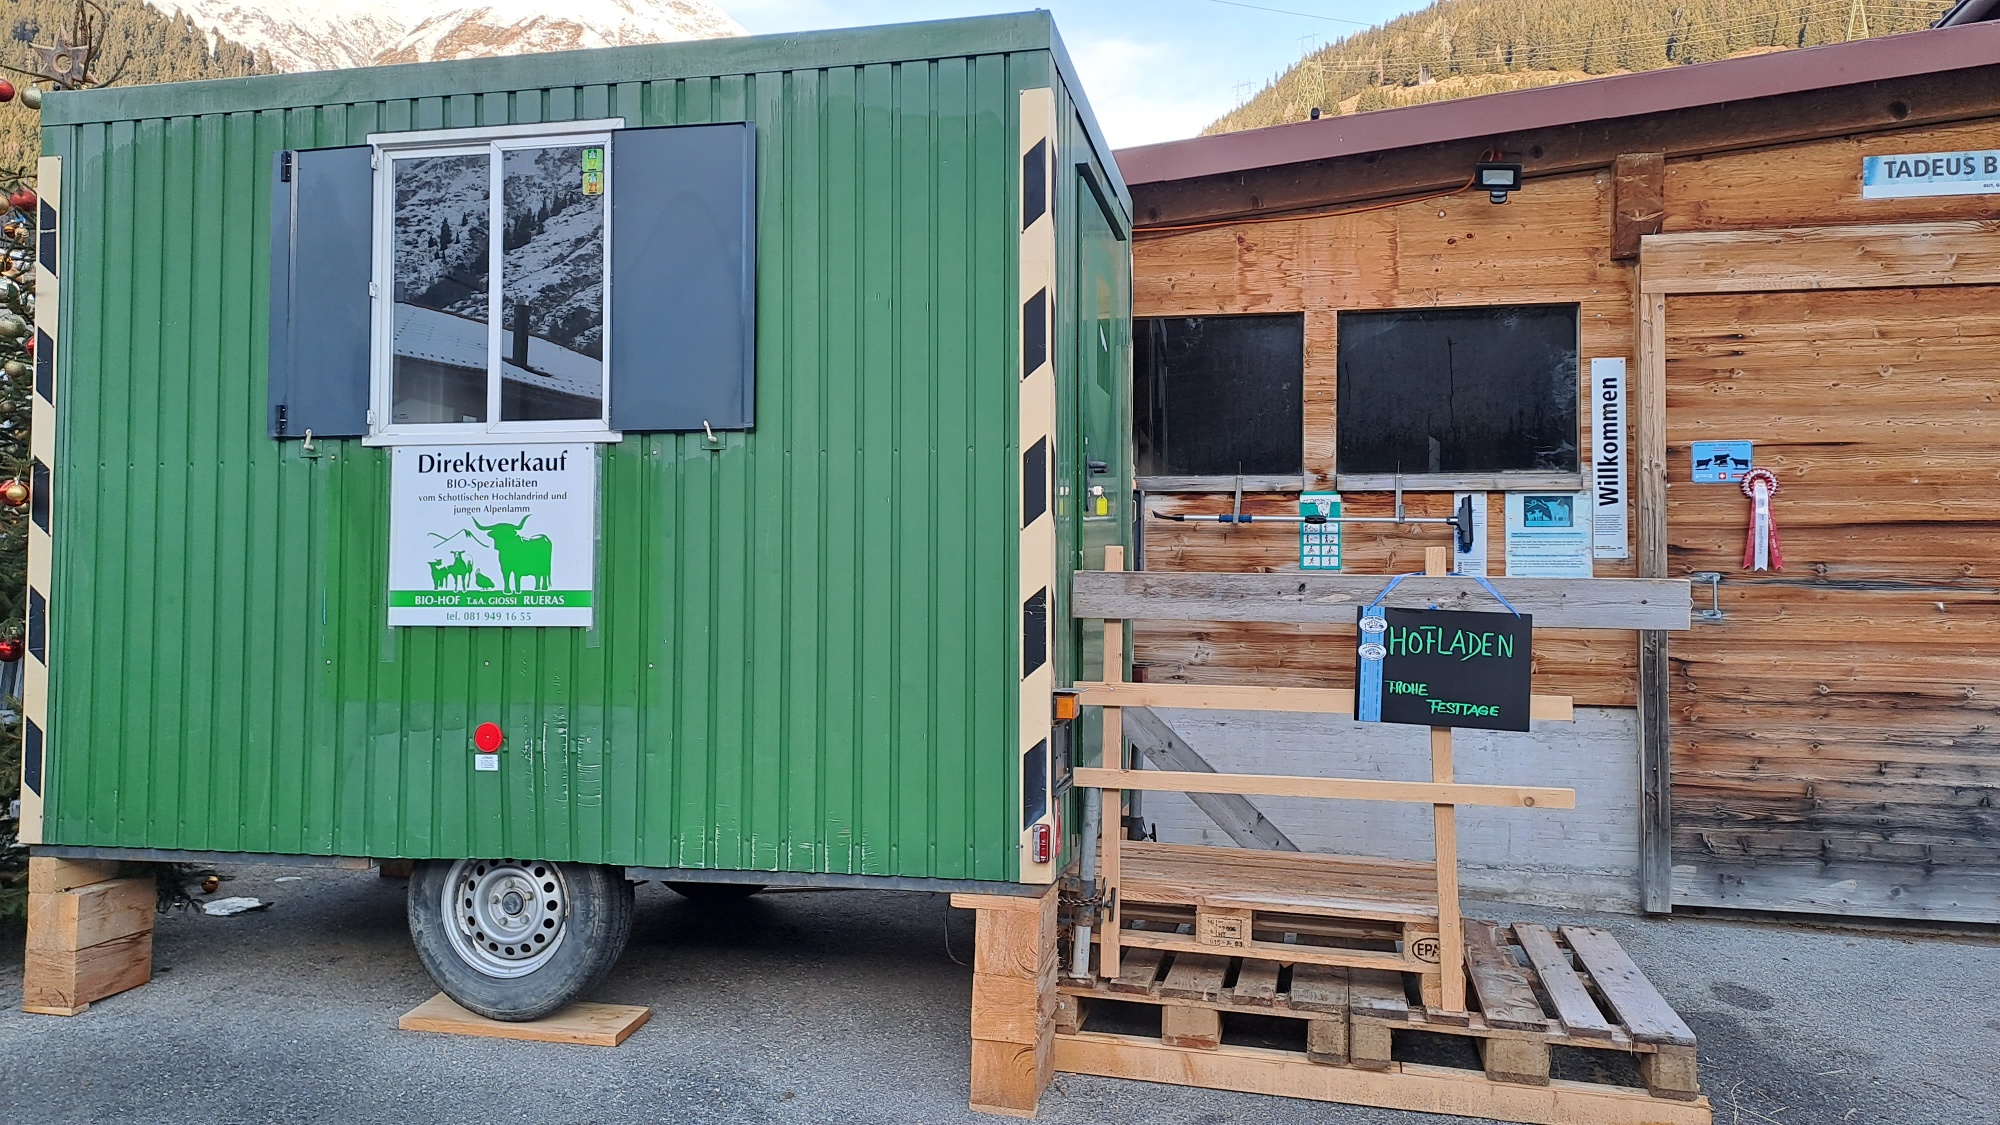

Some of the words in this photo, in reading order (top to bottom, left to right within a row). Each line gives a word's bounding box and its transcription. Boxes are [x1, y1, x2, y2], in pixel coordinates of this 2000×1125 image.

[1884, 156, 1976, 179] TADEUS
[1984, 156, 1998, 175] B
[1597, 377, 1619, 506] Willkommen
[418, 450, 568, 474] Direktverkauf
[446, 477, 538, 491] BIO-Spezialitäten
[418, 494, 436, 502] vom
[437, 492, 489, 502] Schottischen
[491, 491, 549, 501] Hochlandrind
[551, 491, 567, 500] und
[453, 504, 481, 515] jungen
[483, 504, 531, 514] Alpenlamm
[414, 595, 461, 605] BIO-HOF
[488, 596, 518, 605] GIOSSI
[523, 594, 565, 605] RUERAS
[446, 611, 461, 621] tel.
[463, 611, 480, 621] 081
[484, 611, 502, 621] 949
[505, 611, 517, 621] 16
[520, 610, 532, 621] 55
[1389, 625, 1515, 662] HOFLADEN
[1383, 680, 1429, 697] FROHE
[1425, 698, 1501, 717] FESTTAGE
